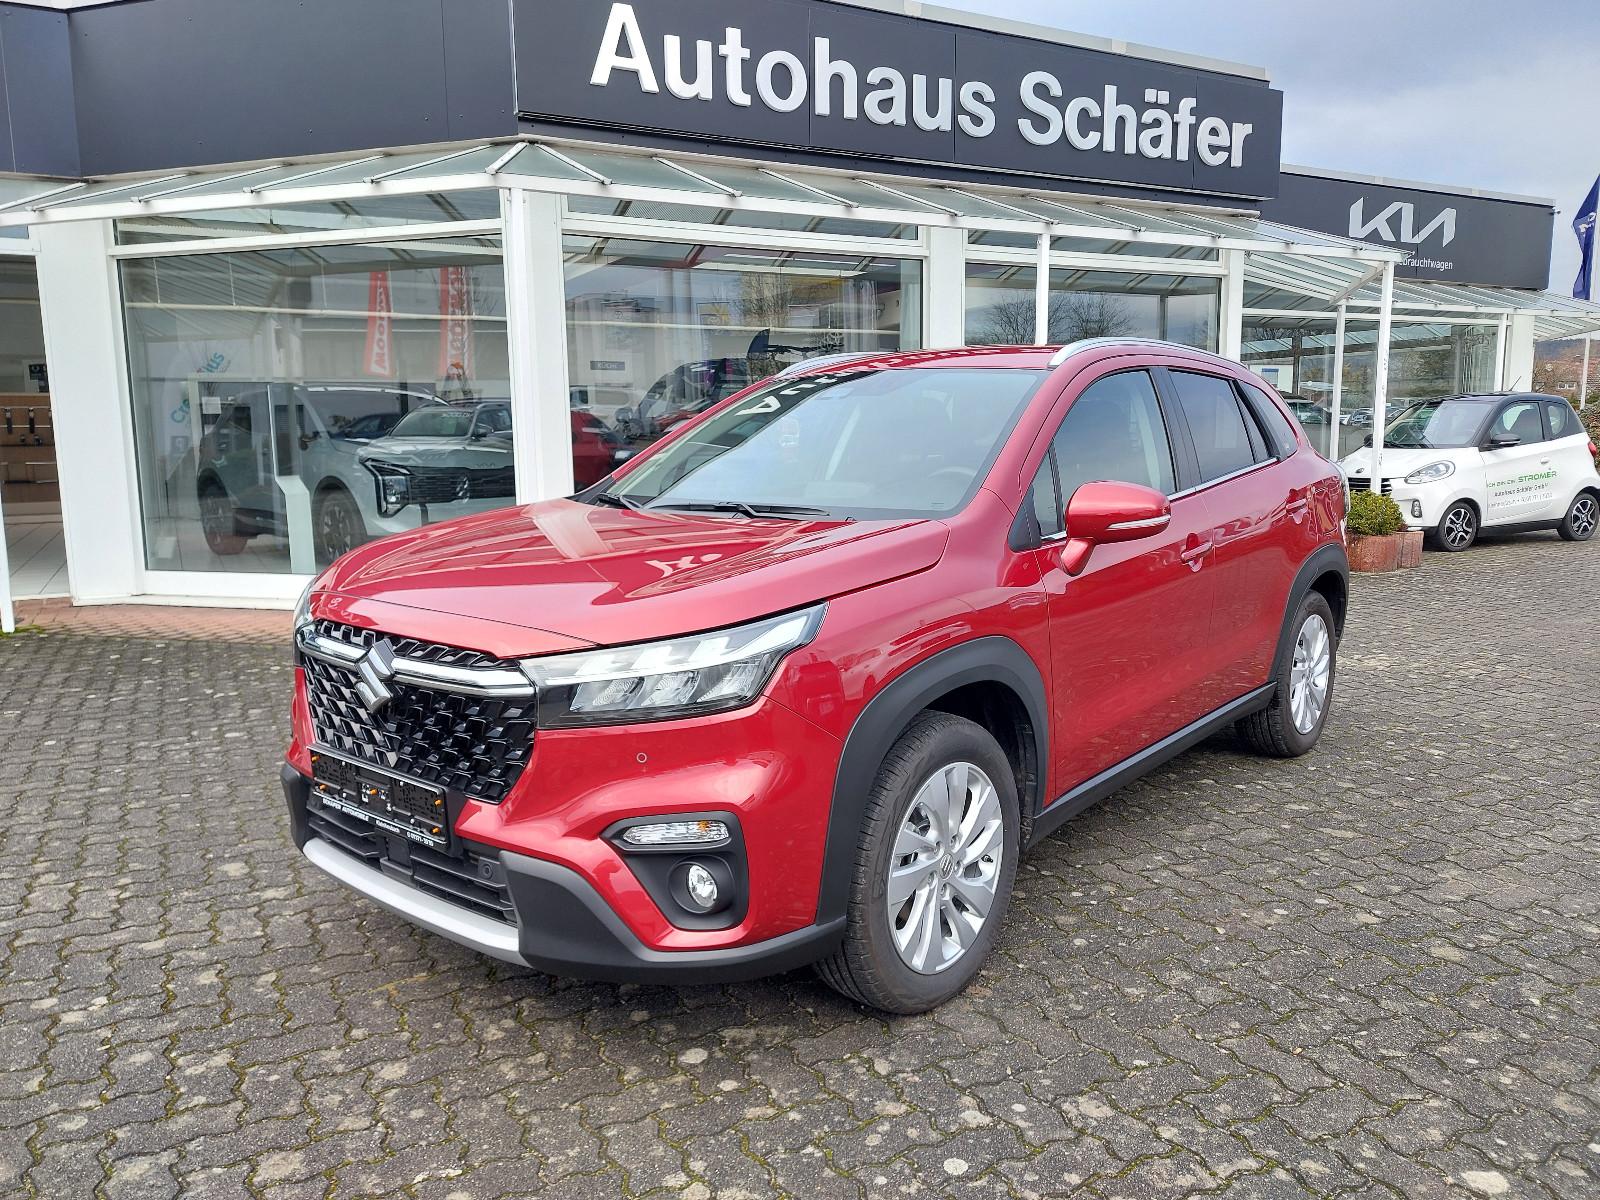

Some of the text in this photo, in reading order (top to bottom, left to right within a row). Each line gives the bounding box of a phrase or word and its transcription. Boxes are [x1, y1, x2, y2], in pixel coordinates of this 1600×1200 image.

[590, 3, 1253, 168] Autohaus Schäfer
[1349, 197, 1456, 247] KIA
[1518, 471, 1557, 483] STROMER
